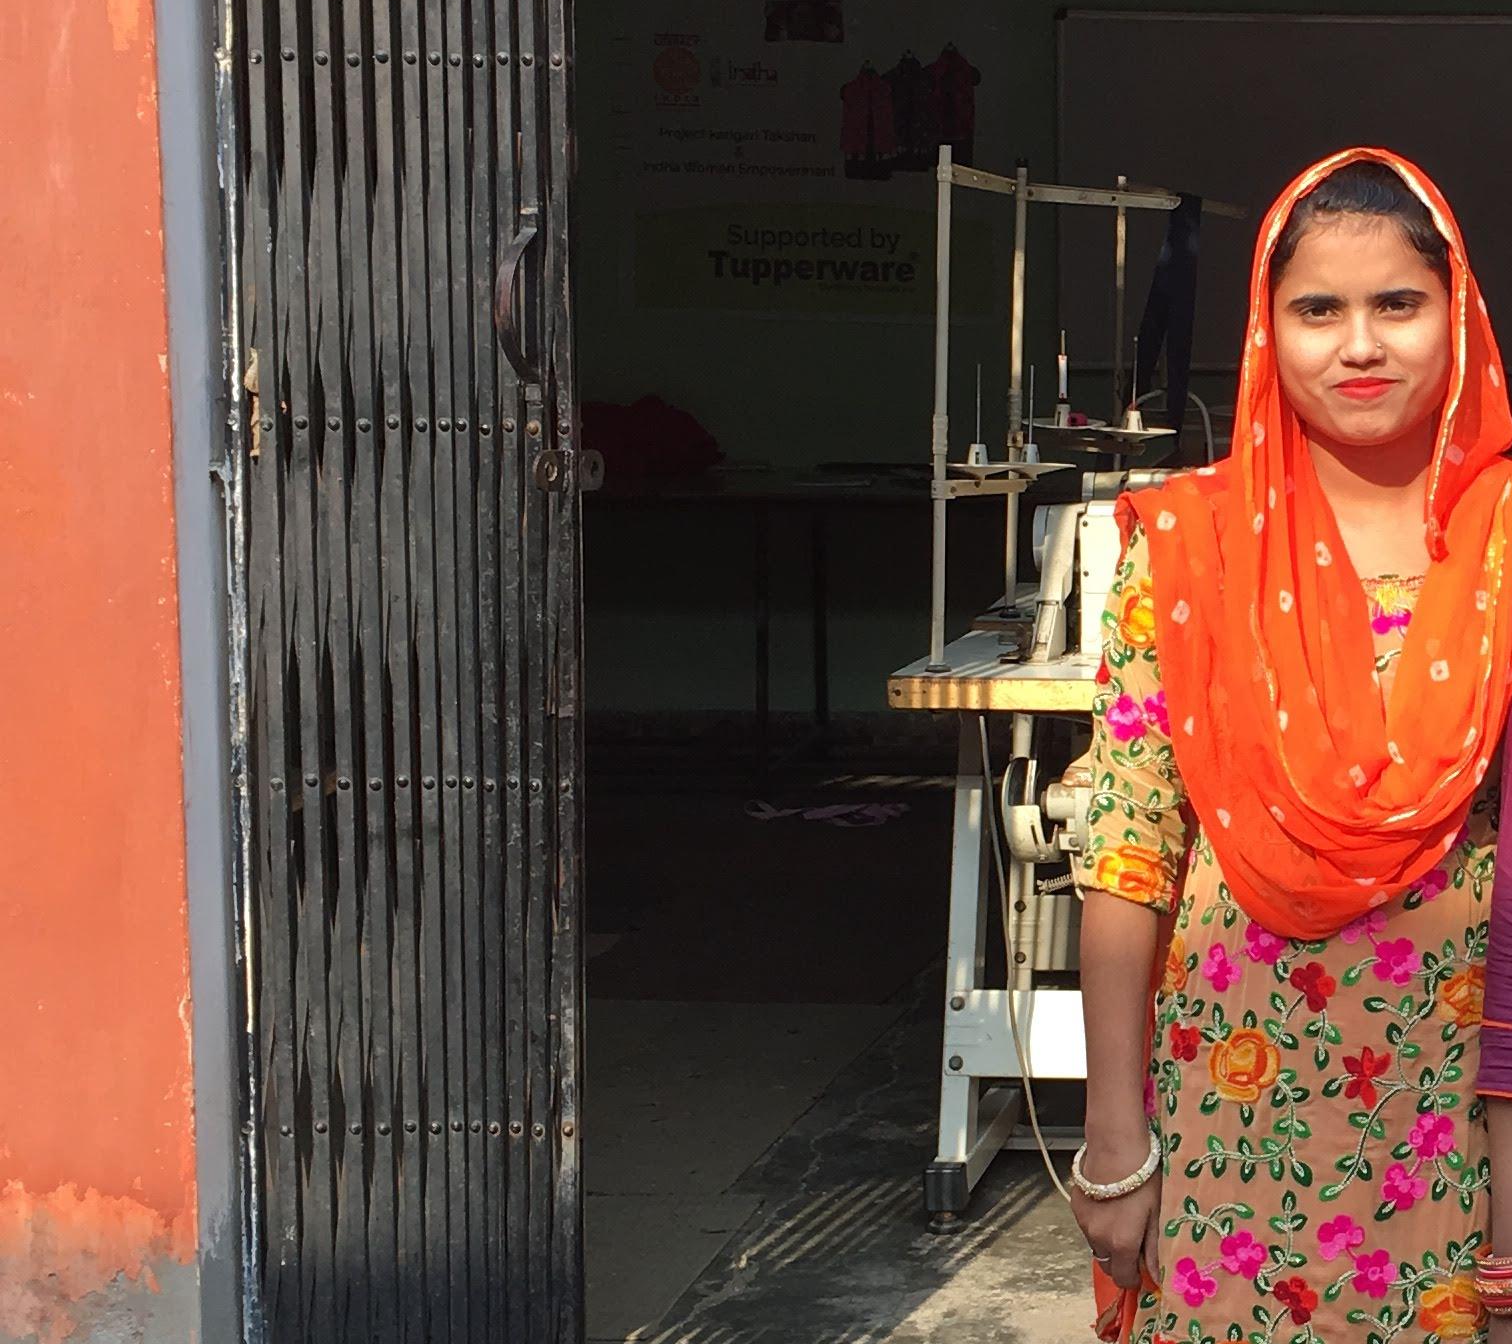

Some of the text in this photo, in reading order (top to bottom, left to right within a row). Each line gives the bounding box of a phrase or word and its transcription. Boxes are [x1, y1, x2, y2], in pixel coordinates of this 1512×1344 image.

[727, 224, 900, 254] Supported by
[708, 249, 914, 286] Tupperware
